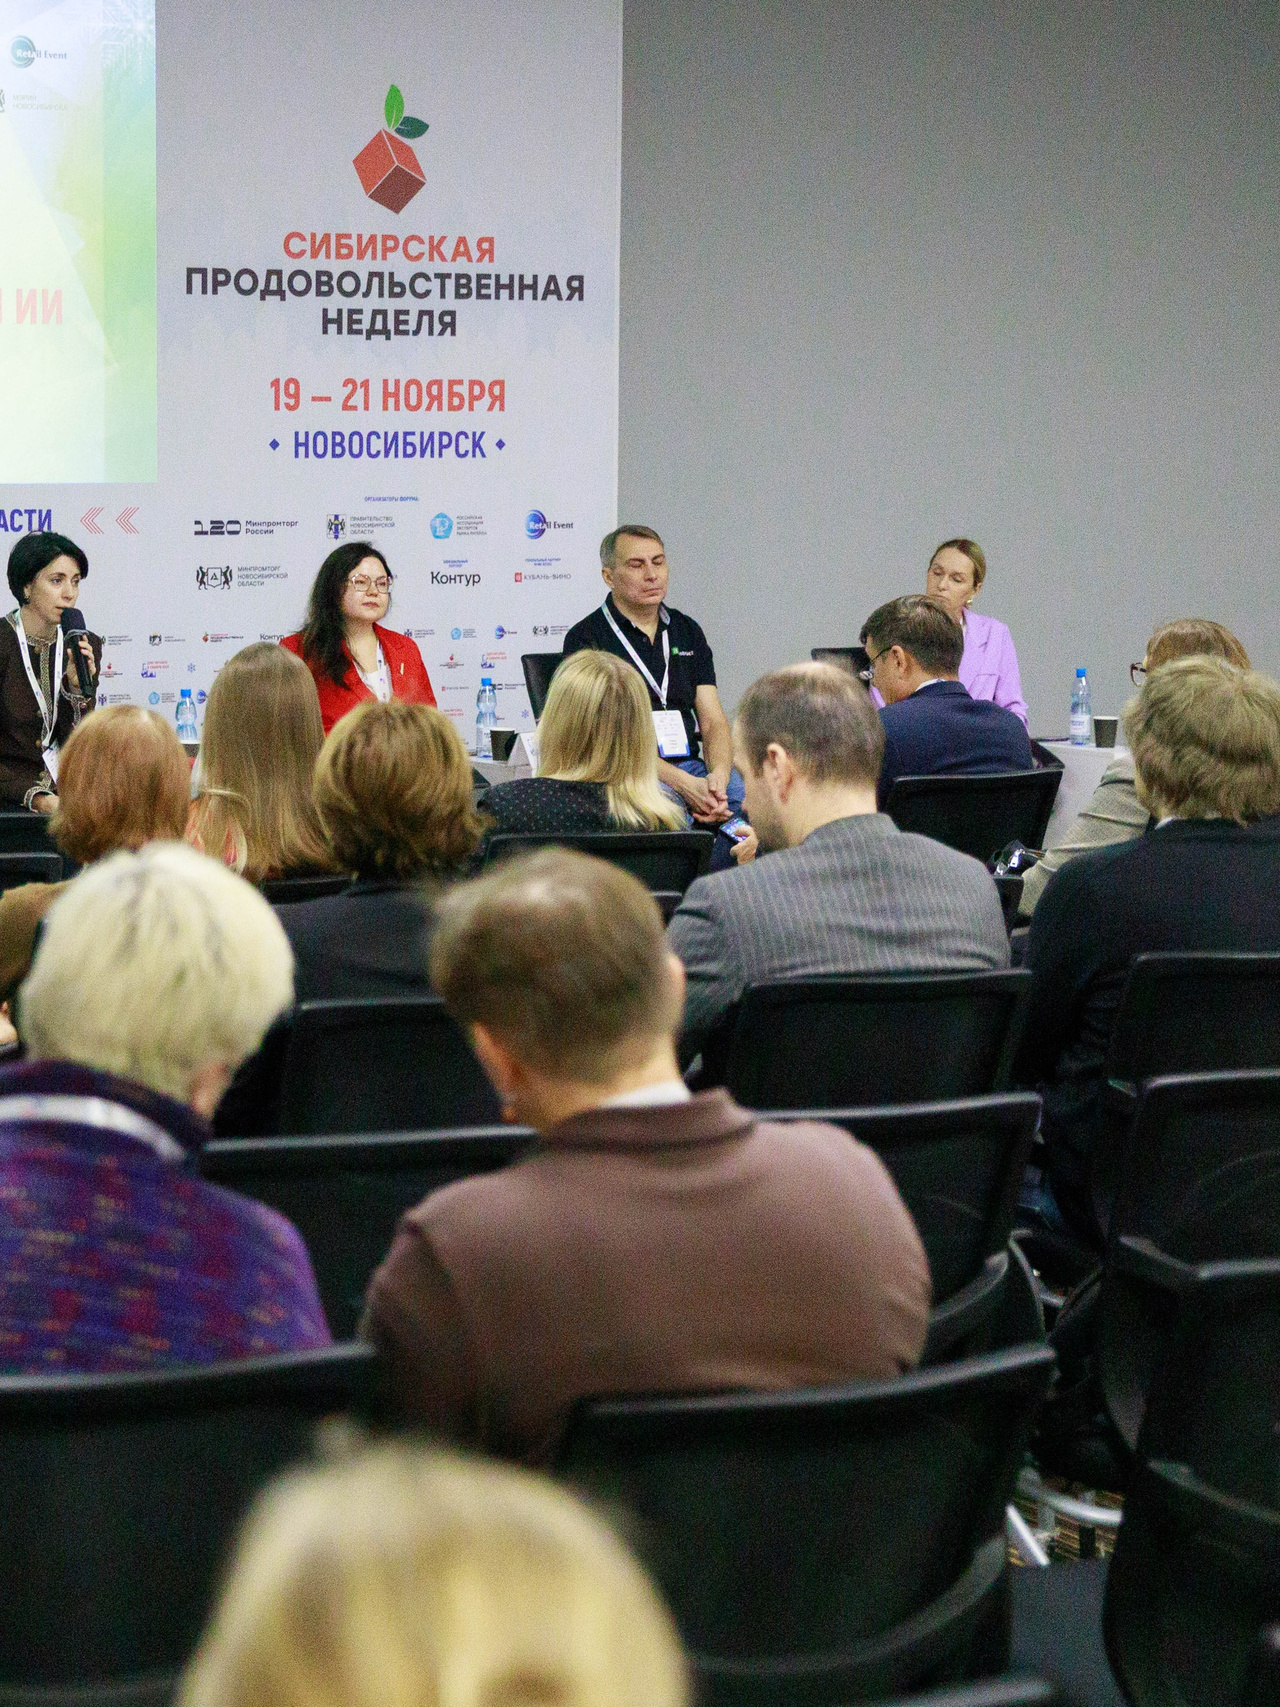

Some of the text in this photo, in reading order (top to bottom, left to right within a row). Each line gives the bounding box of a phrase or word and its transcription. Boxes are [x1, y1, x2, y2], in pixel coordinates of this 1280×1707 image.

[45, 50, 67, 60] Event
[283, 231, 495, 263] СИБИРСКАЯ
[186, 267, 584, 301] ПРОДОВОЛЬСТВЕННАЯ
[15, 290, 63, 325] ИИ
[321, 308, 457, 340] НЕДЕЛЯ
[270, 378, 301, 411] 19
[342, 379, 370, 411] 21
[382, 379, 506, 412] НОЯБРЯ
[294, 430, 486, 459] НОВОСИБИРСК
[194, 520, 299, 536] 120 Минпромторг
[553, 521, 574, 530] Event
[238, 565, 281, 573] МИНПРОМТОРГ
[238, 572, 288, 580] НОВОСИБИРСКОЙ
[430, 571, 481, 587] Контур
